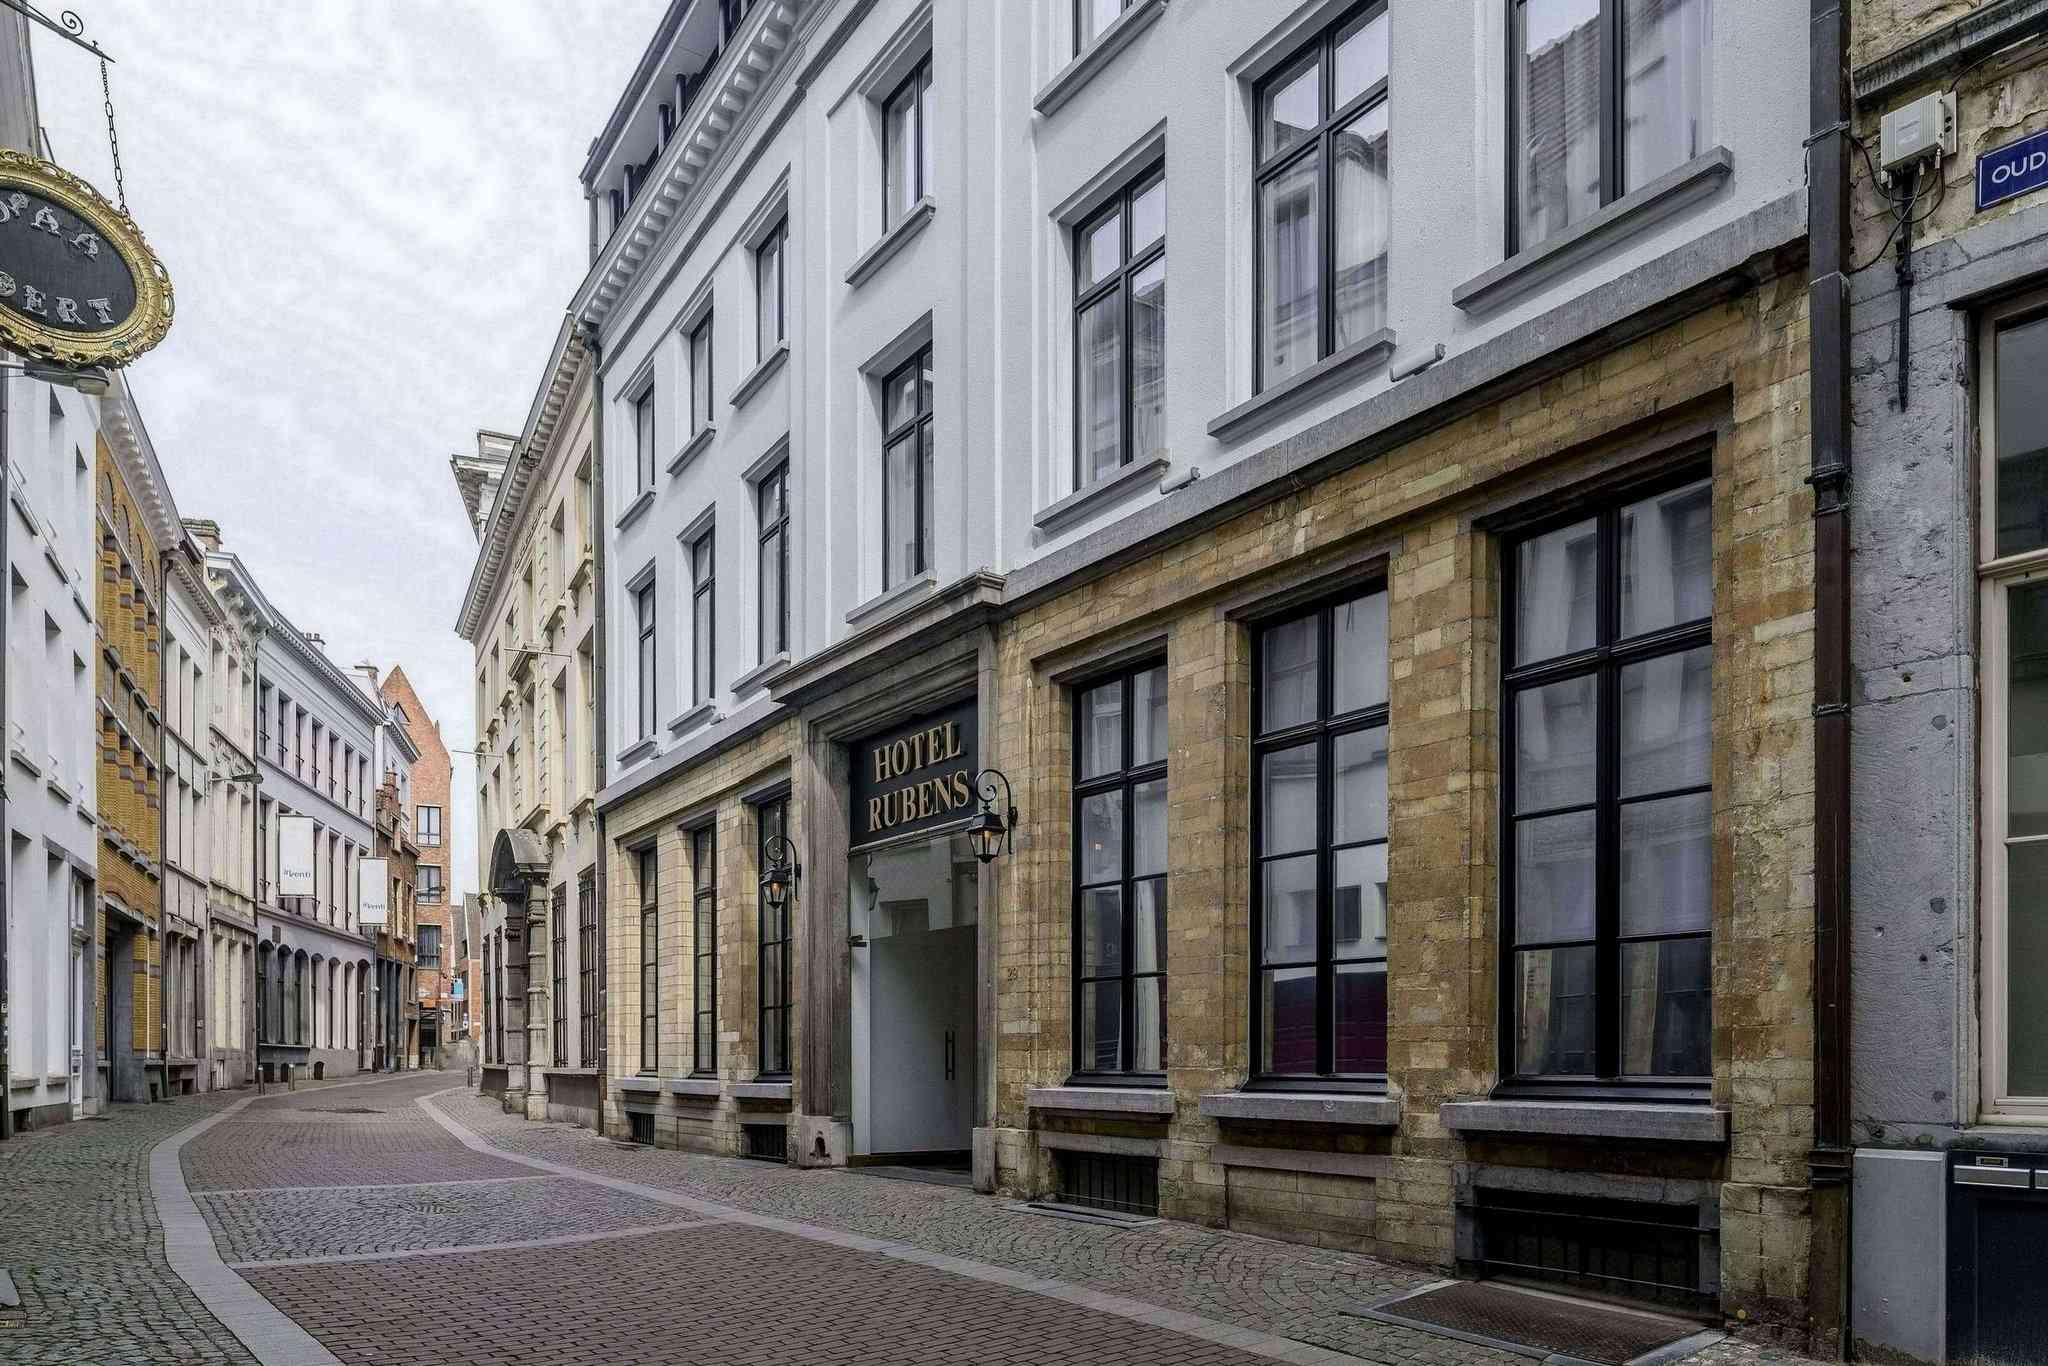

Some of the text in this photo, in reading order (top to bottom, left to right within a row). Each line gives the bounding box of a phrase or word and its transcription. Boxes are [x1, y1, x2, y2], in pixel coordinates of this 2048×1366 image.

[1992, 151, 2048, 183] OUD
[873, 721, 961, 783] HOTEL
[868, 769, 970, 832] RUBENS
